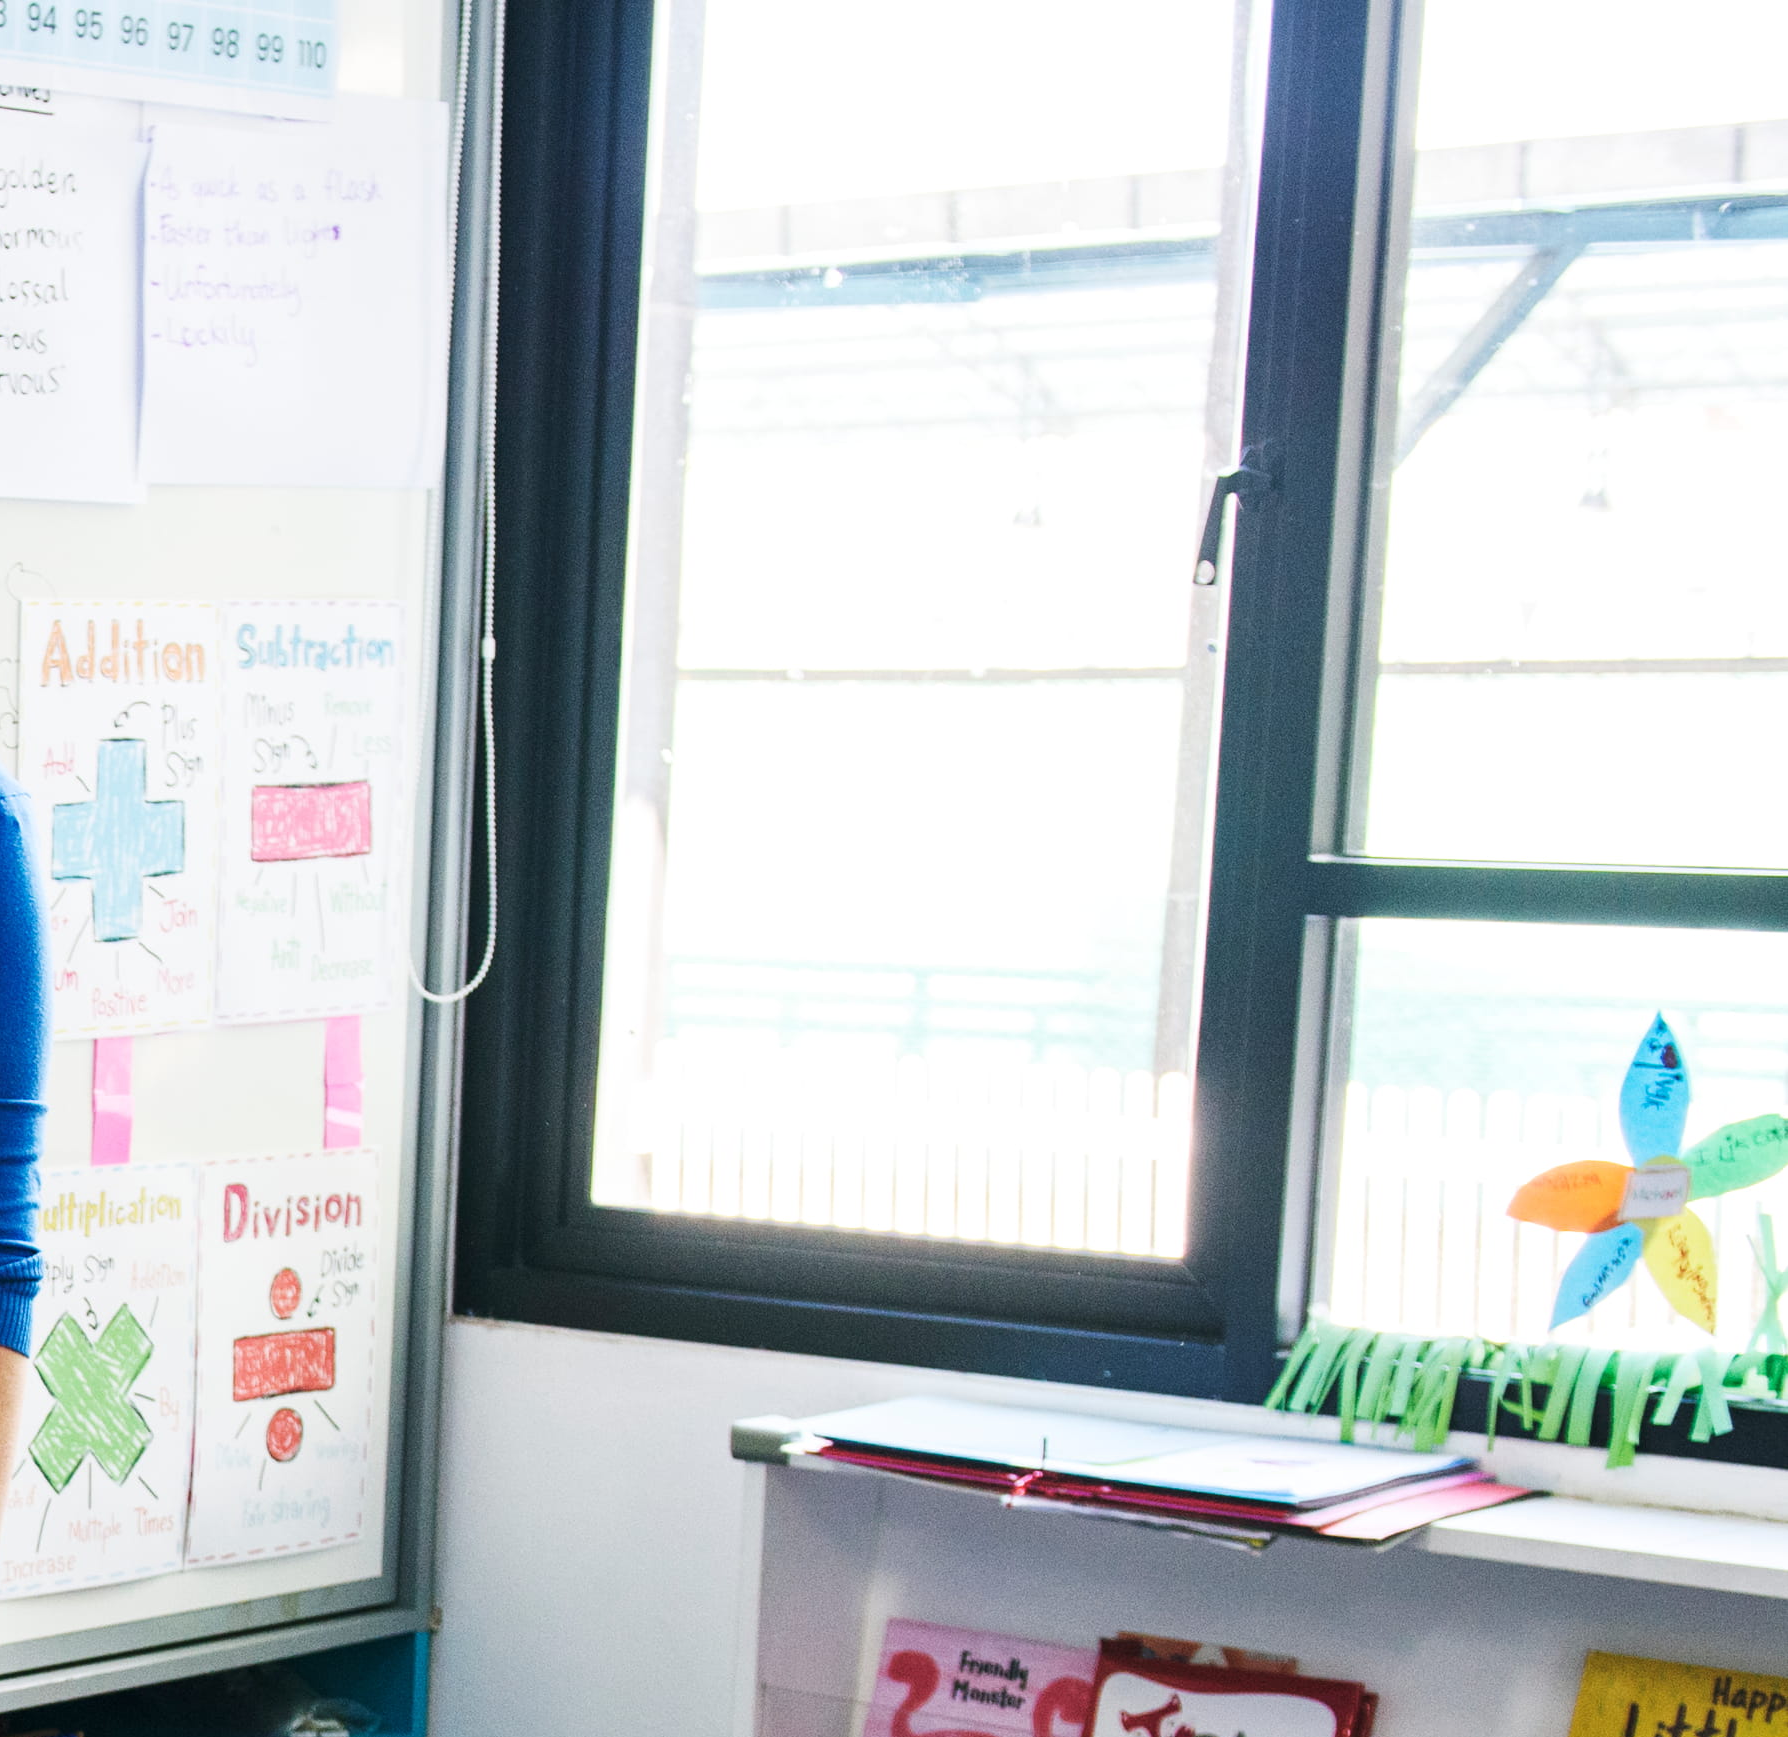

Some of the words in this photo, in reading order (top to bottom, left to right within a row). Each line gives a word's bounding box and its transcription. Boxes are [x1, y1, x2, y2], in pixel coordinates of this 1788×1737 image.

[26, 2, 58, 34] 94
[74, 9, 104, 40] 95
[120, 15, 150, 47] 96
[167, 22, 195, 52] 97
[211, 27, 240, 60] 98
[256, 32, 285, 64] 99
[38, 618, 207, 688] Addition
[235, 622, 397, 672] Subtraction
[159, 697, 198, 752] Plus
[243, 690, 296, 730] Minus
[158, 898, 200, 935] Join
[155, 966, 196, 993] More
[91, 987, 149, 1021] Positive
[38, 1186, 183, 1238] ultiplication
[222, 1180, 364, 1244] Division
[319, 1246, 365, 1280] Divide
[134, 1505, 175, 1537] Times
[2, 1552, 78, 1582] Increase
[959, 1649, 1030, 1690] Friendly
[951, 1680, 1027, 1710] Monster
[1711, 1675, 1788, 1723] Happ
